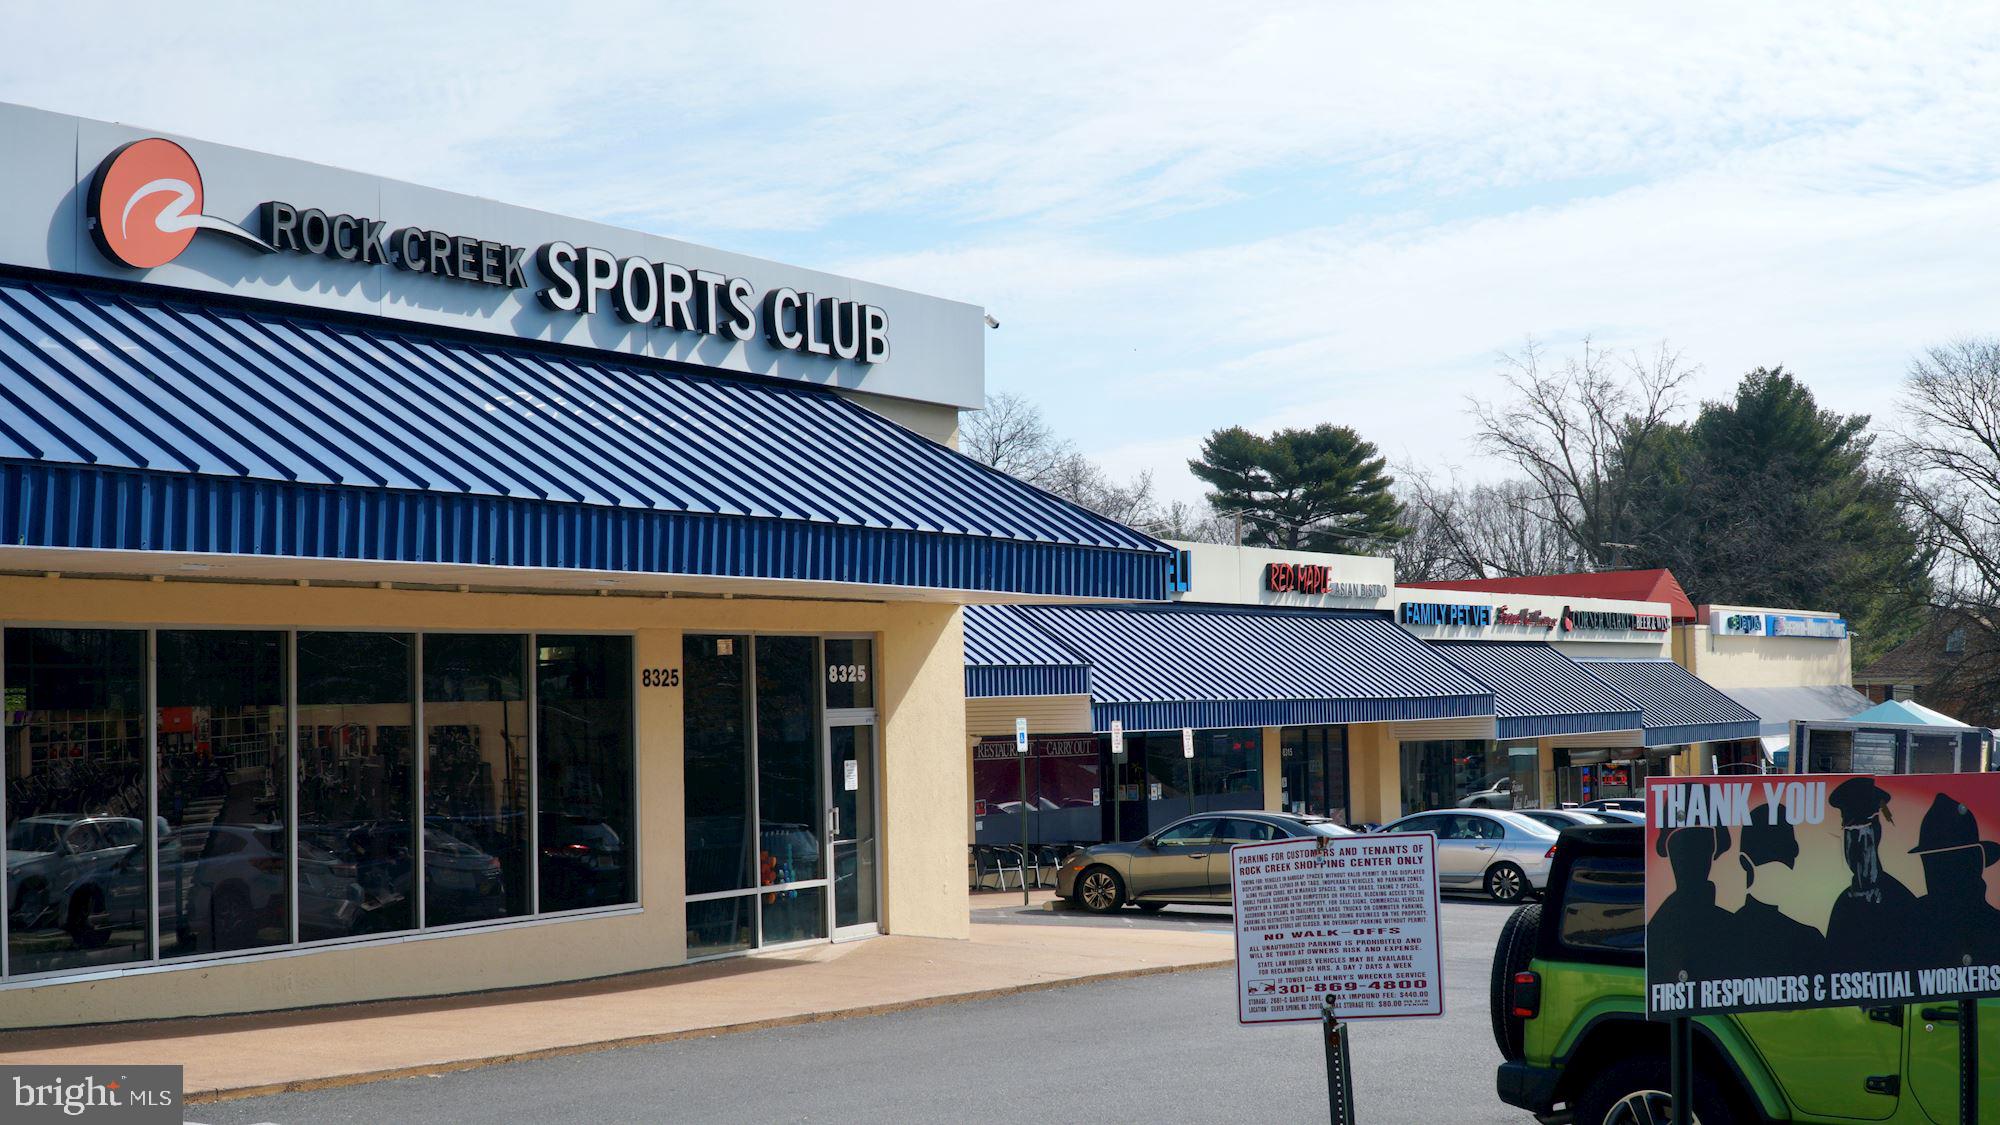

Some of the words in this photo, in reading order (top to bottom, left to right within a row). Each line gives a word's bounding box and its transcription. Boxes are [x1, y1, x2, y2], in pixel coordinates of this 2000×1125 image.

[263, 201, 389, 265] ROCK
[392, 227, 528, 288] CREEK
[538, 241, 757, 341] SPORTS
[765, 287, 891, 364] CLUB
[1268, 563, 1294, 592] RED
[1299, 564, 1333, 594] MAPLE
[1334, 582, 1358, 598] ASIAN
[1360, 583, 1387, 598] BISTRO
[1405, 602, 1446, 626] FAMILY
[1450, 603, 1470, 626] PET
[1473, 604, 1493, 626] VET
[642, 668, 679, 687] 8325
[829, 665, 867, 683] 8325
[1046, 741, 1073, 755] CARRY
[1073, 740, 1092, 754] OUT
[1651, 783, 1752, 829] THANK
[1763, 781, 1826, 826] YOU
[1239, 854, 1269, 864] PARKING
[1271, 852, 1284, 861] FOR
[1339, 847, 1357, 856] AND
[1362, 845, 1408, 855] TENANTS
[1412, 844, 1424, 853] OF
[1240, 866, 1261, 876] ROCK
[1265, 863, 1291, 873] CREEK
[1295, 859, 1345, 870] SHOPPING
[1350, 857, 1392, 867] CENTER
[1397, 856, 1424, 865] ONLY
[1264, 933, 1284, 941] NO
[1262, 942, 1306, 951] UNAUTHORIZED
[1307, 947, 1339, 955] OWNERS
[1288, 958, 1312, 966] REQUIRES
[1377, 954, 1414, 962] AVAILABLE
[1270, 966, 1305, 975] RECLAMATION
[1395, 971, 1427, 979] SERVICE
[1278, 979, 1427, 994] 301-869-4800
[1652, 980, 1696, 1012] FIRST
[1700, 974, 1809, 1008] RESPONDERS
[1814, 974, 1827, 1001] &
[1917, 965, 2000, 995] WORKERS
[1348, 992, 1380, 1000] IMPOUND
[1399, 990, 1429, 998] $440.00
